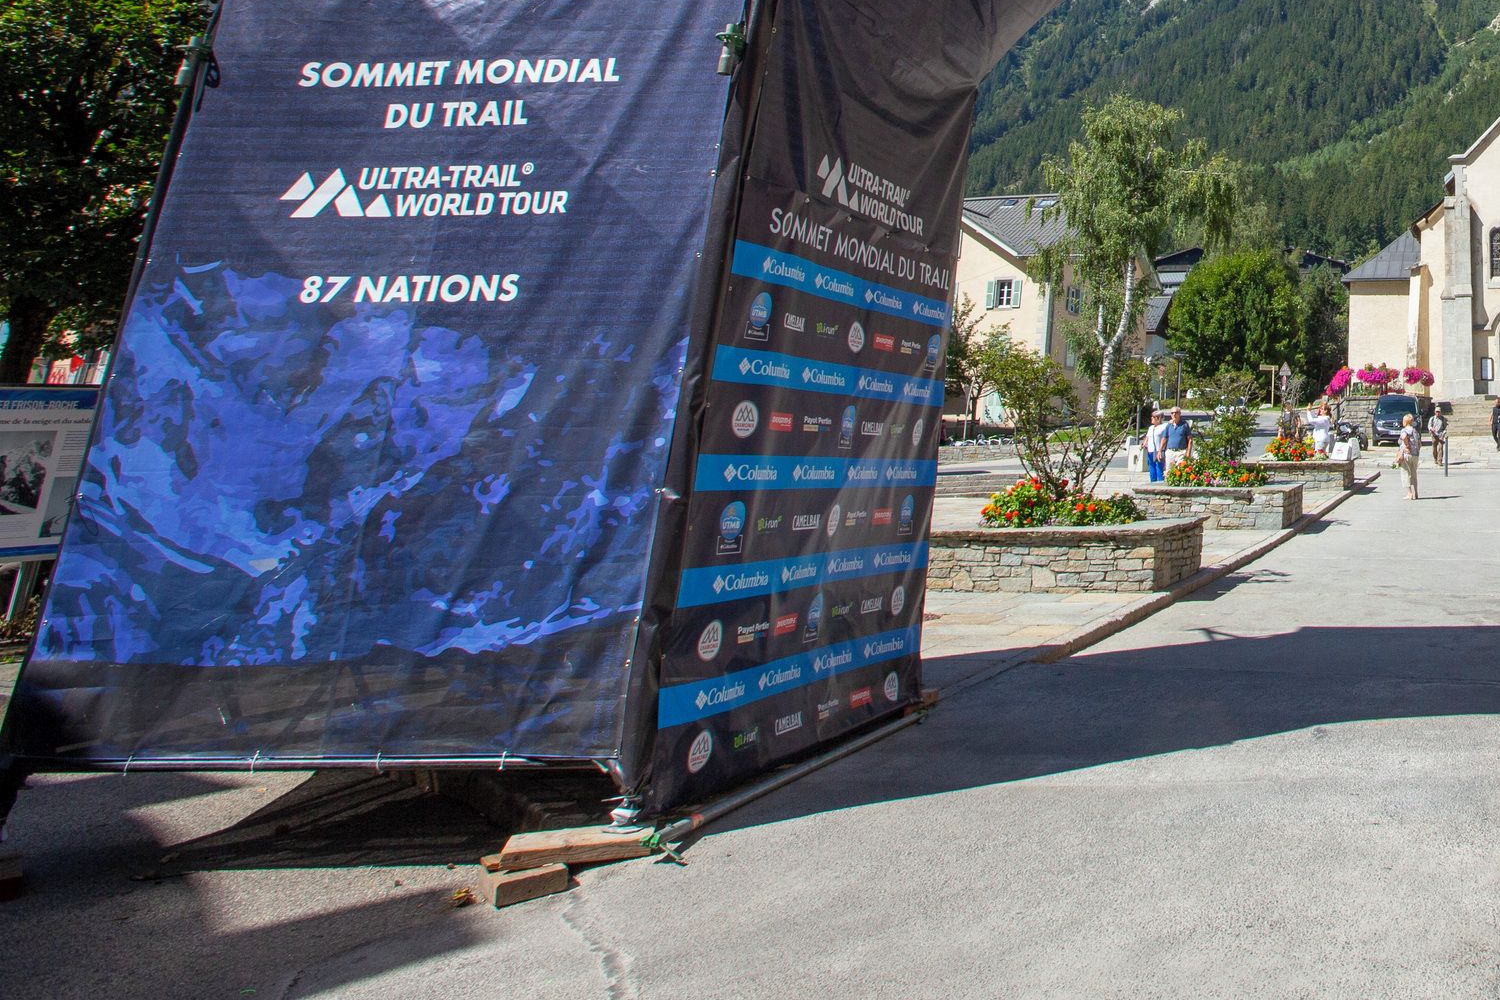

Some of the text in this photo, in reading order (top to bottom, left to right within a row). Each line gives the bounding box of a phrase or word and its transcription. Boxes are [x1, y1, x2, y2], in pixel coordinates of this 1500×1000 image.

[298, 57, 620, 89] SOMMET MONDIAL
[384, 100, 528, 129] DU TRAIL
[396, 190, 569, 217] WORLD TOUR
[858, 193, 923, 237] WORLD TOUR
[769, 207, 951, 291] SOMMET MONDIAL DU TRAIL
[768, 257, 806, 283] Columbia
[299, 273, 520, 304] 87 NATIONS
[821, 273, 855, 298] Columbia
[873, 289, 903, 311] Columbia
[751, 358, 791, 380] Columbia
[810, 367, 845, 387] Columbia
[865, 375, 893, 393] Columbia
[11, 400, 79, 410] FRISON-ROCHE
[737, 464, 777, 481] Columbia
[801, 465, 835, 480] Columbia
[834, 558, 863, 573] Columbia
[880, 552, 911, 566] Columbia
[724, 573, 769, 591] Columbia
[871, 637, 904, 654] Columbia
[766, 665, 801, 687] Columbia
